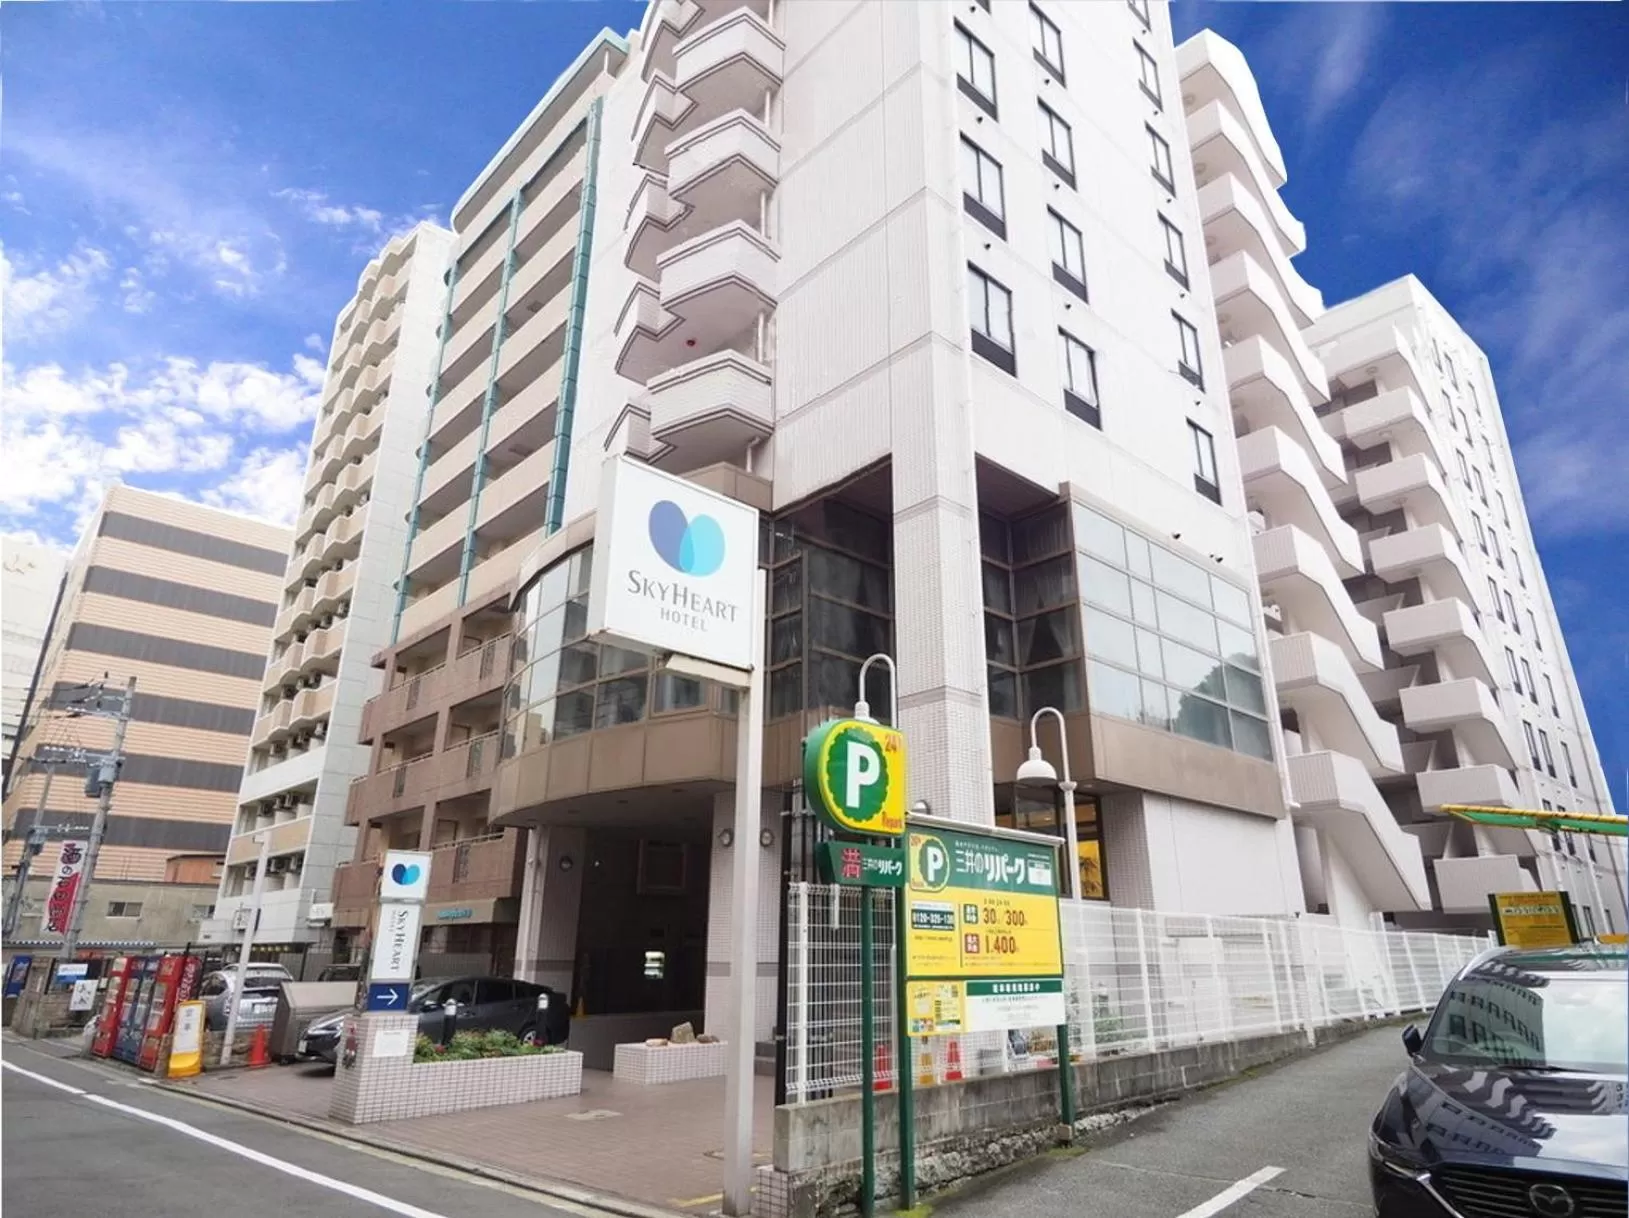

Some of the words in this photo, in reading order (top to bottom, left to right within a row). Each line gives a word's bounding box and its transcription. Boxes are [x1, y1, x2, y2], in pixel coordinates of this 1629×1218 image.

[627, 569, 739, 623] SKYHEART
[660, 607, 709, 632] HOTEL
[846, 740, 880, 808] P
[926, 846, 944, 882] P
[955, 849, 1025, 885] 三井のリパーク
